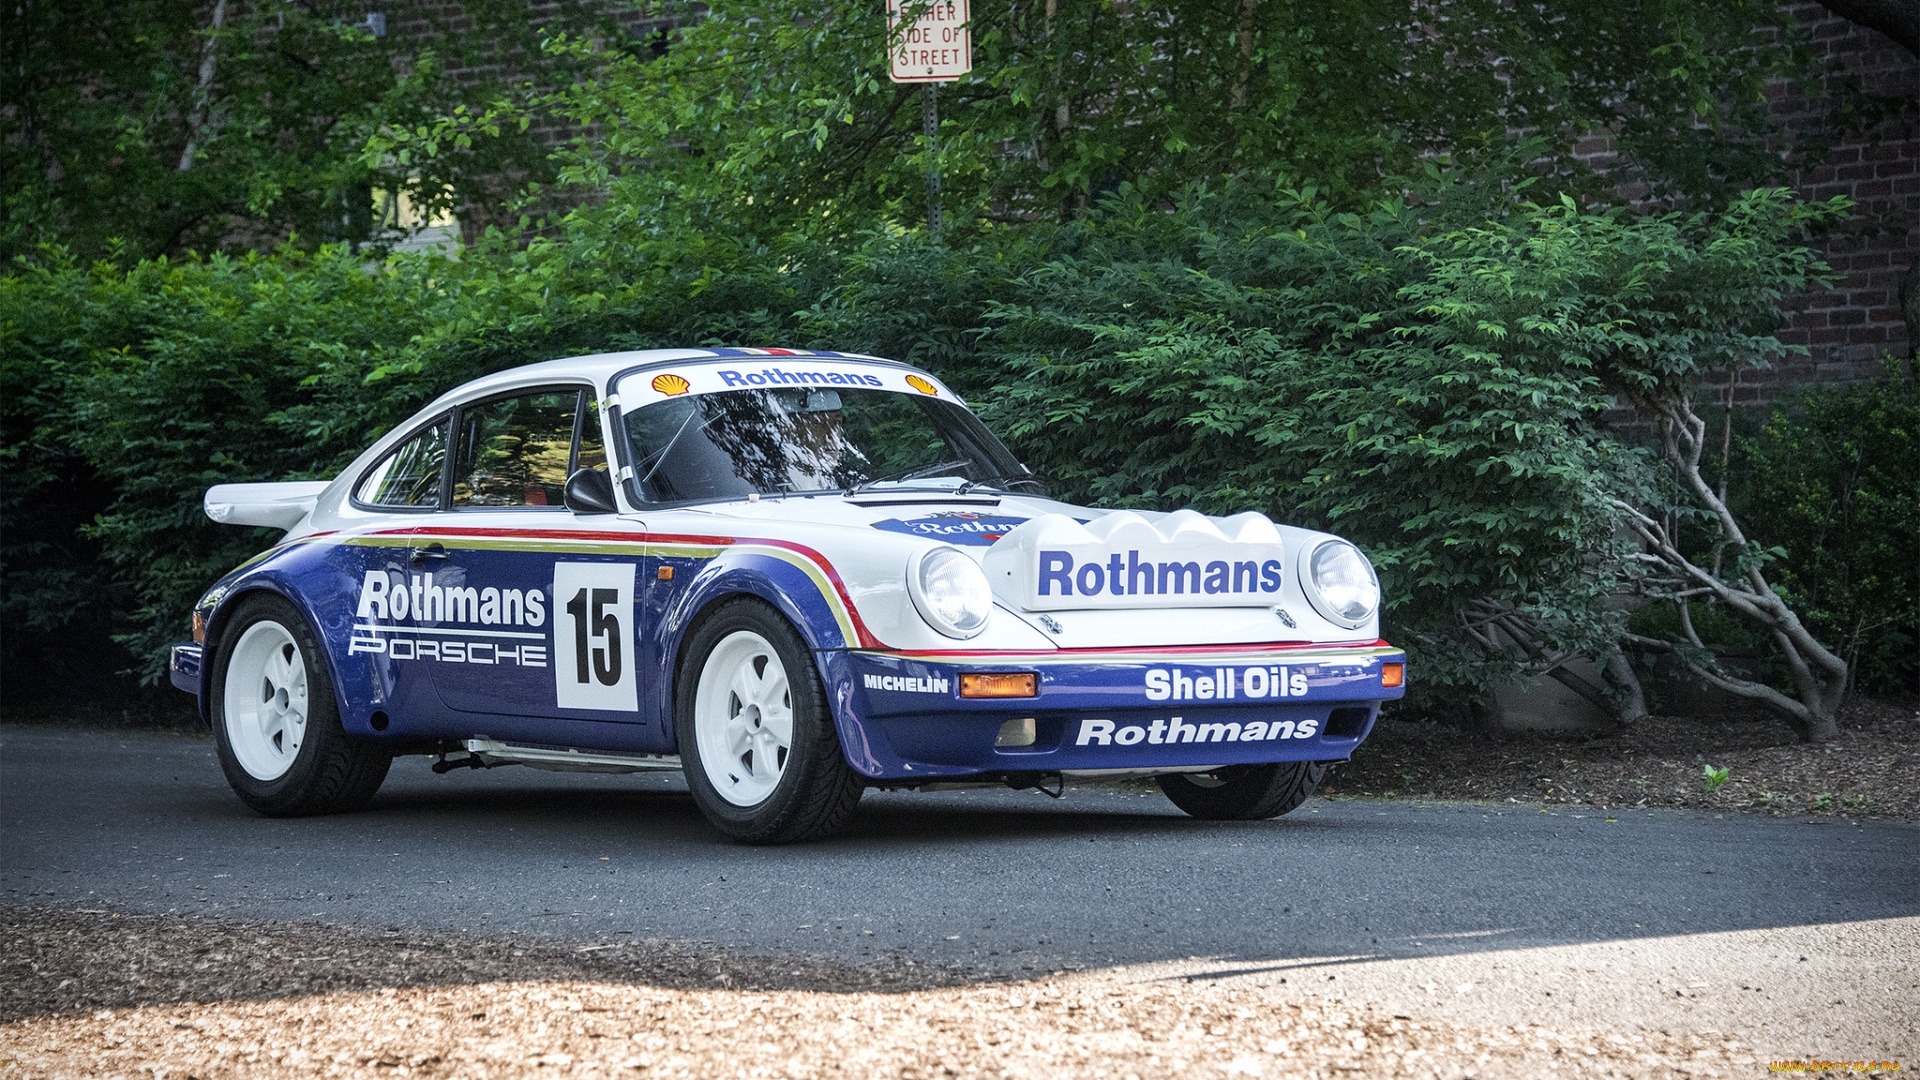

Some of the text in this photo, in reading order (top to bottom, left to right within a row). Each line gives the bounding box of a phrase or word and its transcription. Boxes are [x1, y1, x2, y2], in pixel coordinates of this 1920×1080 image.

[900, 5, 956, 21] EHER
[942, 27, 959, 43] OF
[900, 49, 959, 66] STREET
[717, 368, 884, 387] Rothmans
[904, 521, 1021, 535] Rothm
[1037, 550, 1282, 596] Rothmans
[356, 570, 546, 626] Rothmans
[566, 587, 622, 686] 15
[348, 636, 547, 667] PORSCHE
[864, 674, 948, 694] MICHELIN
[1145, 667, 1308, 700] Shell Oils
[1075, 717, 1319, 746] Rothmans
